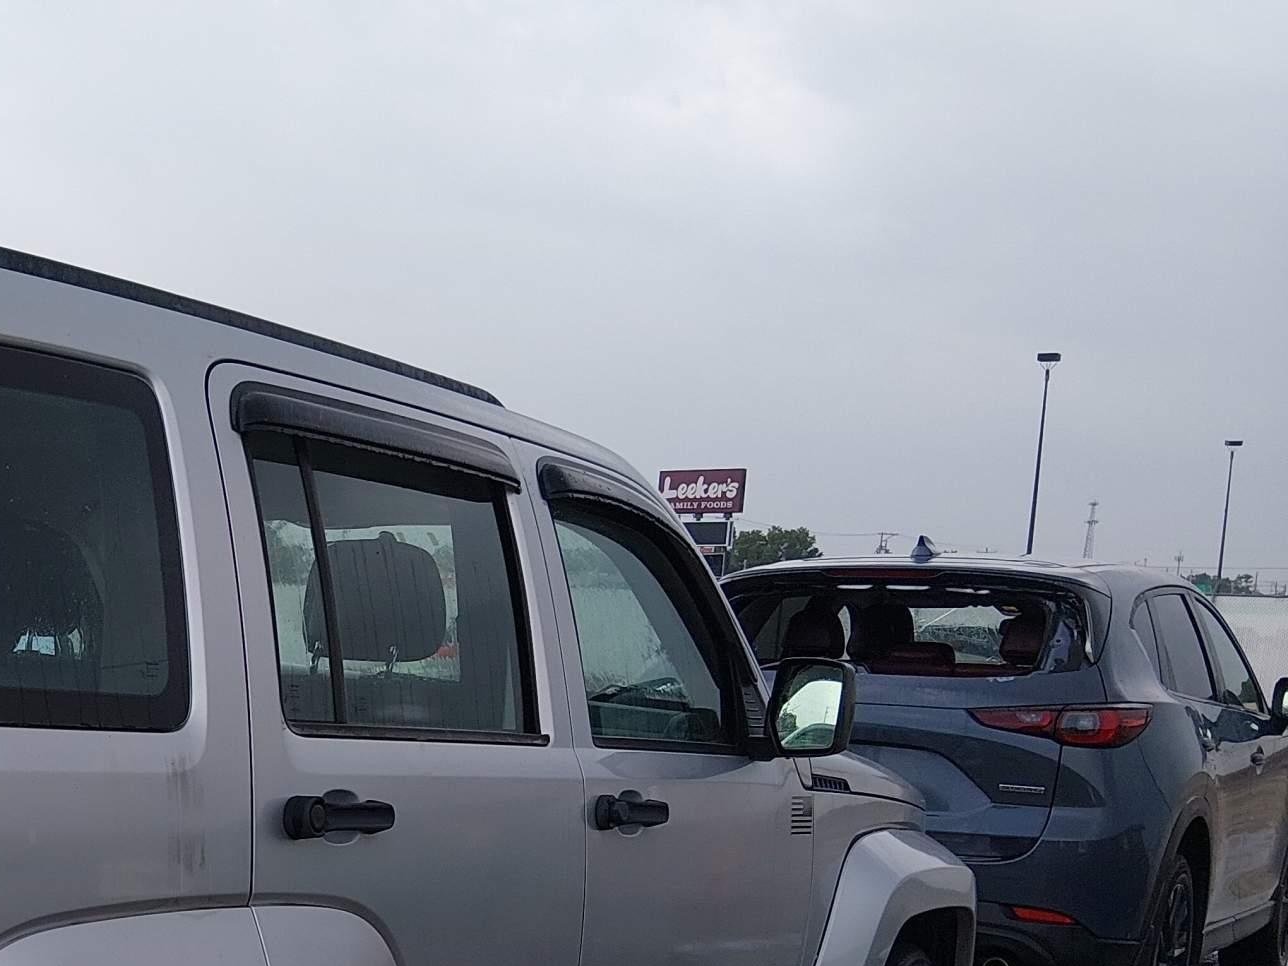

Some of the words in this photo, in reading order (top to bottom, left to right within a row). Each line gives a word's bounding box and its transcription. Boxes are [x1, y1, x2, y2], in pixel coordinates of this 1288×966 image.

[660, 475, 740, 500] Leeker's
[670, 501, 699, 509] AMILY
[700, 500, 733, 509] FOODS
